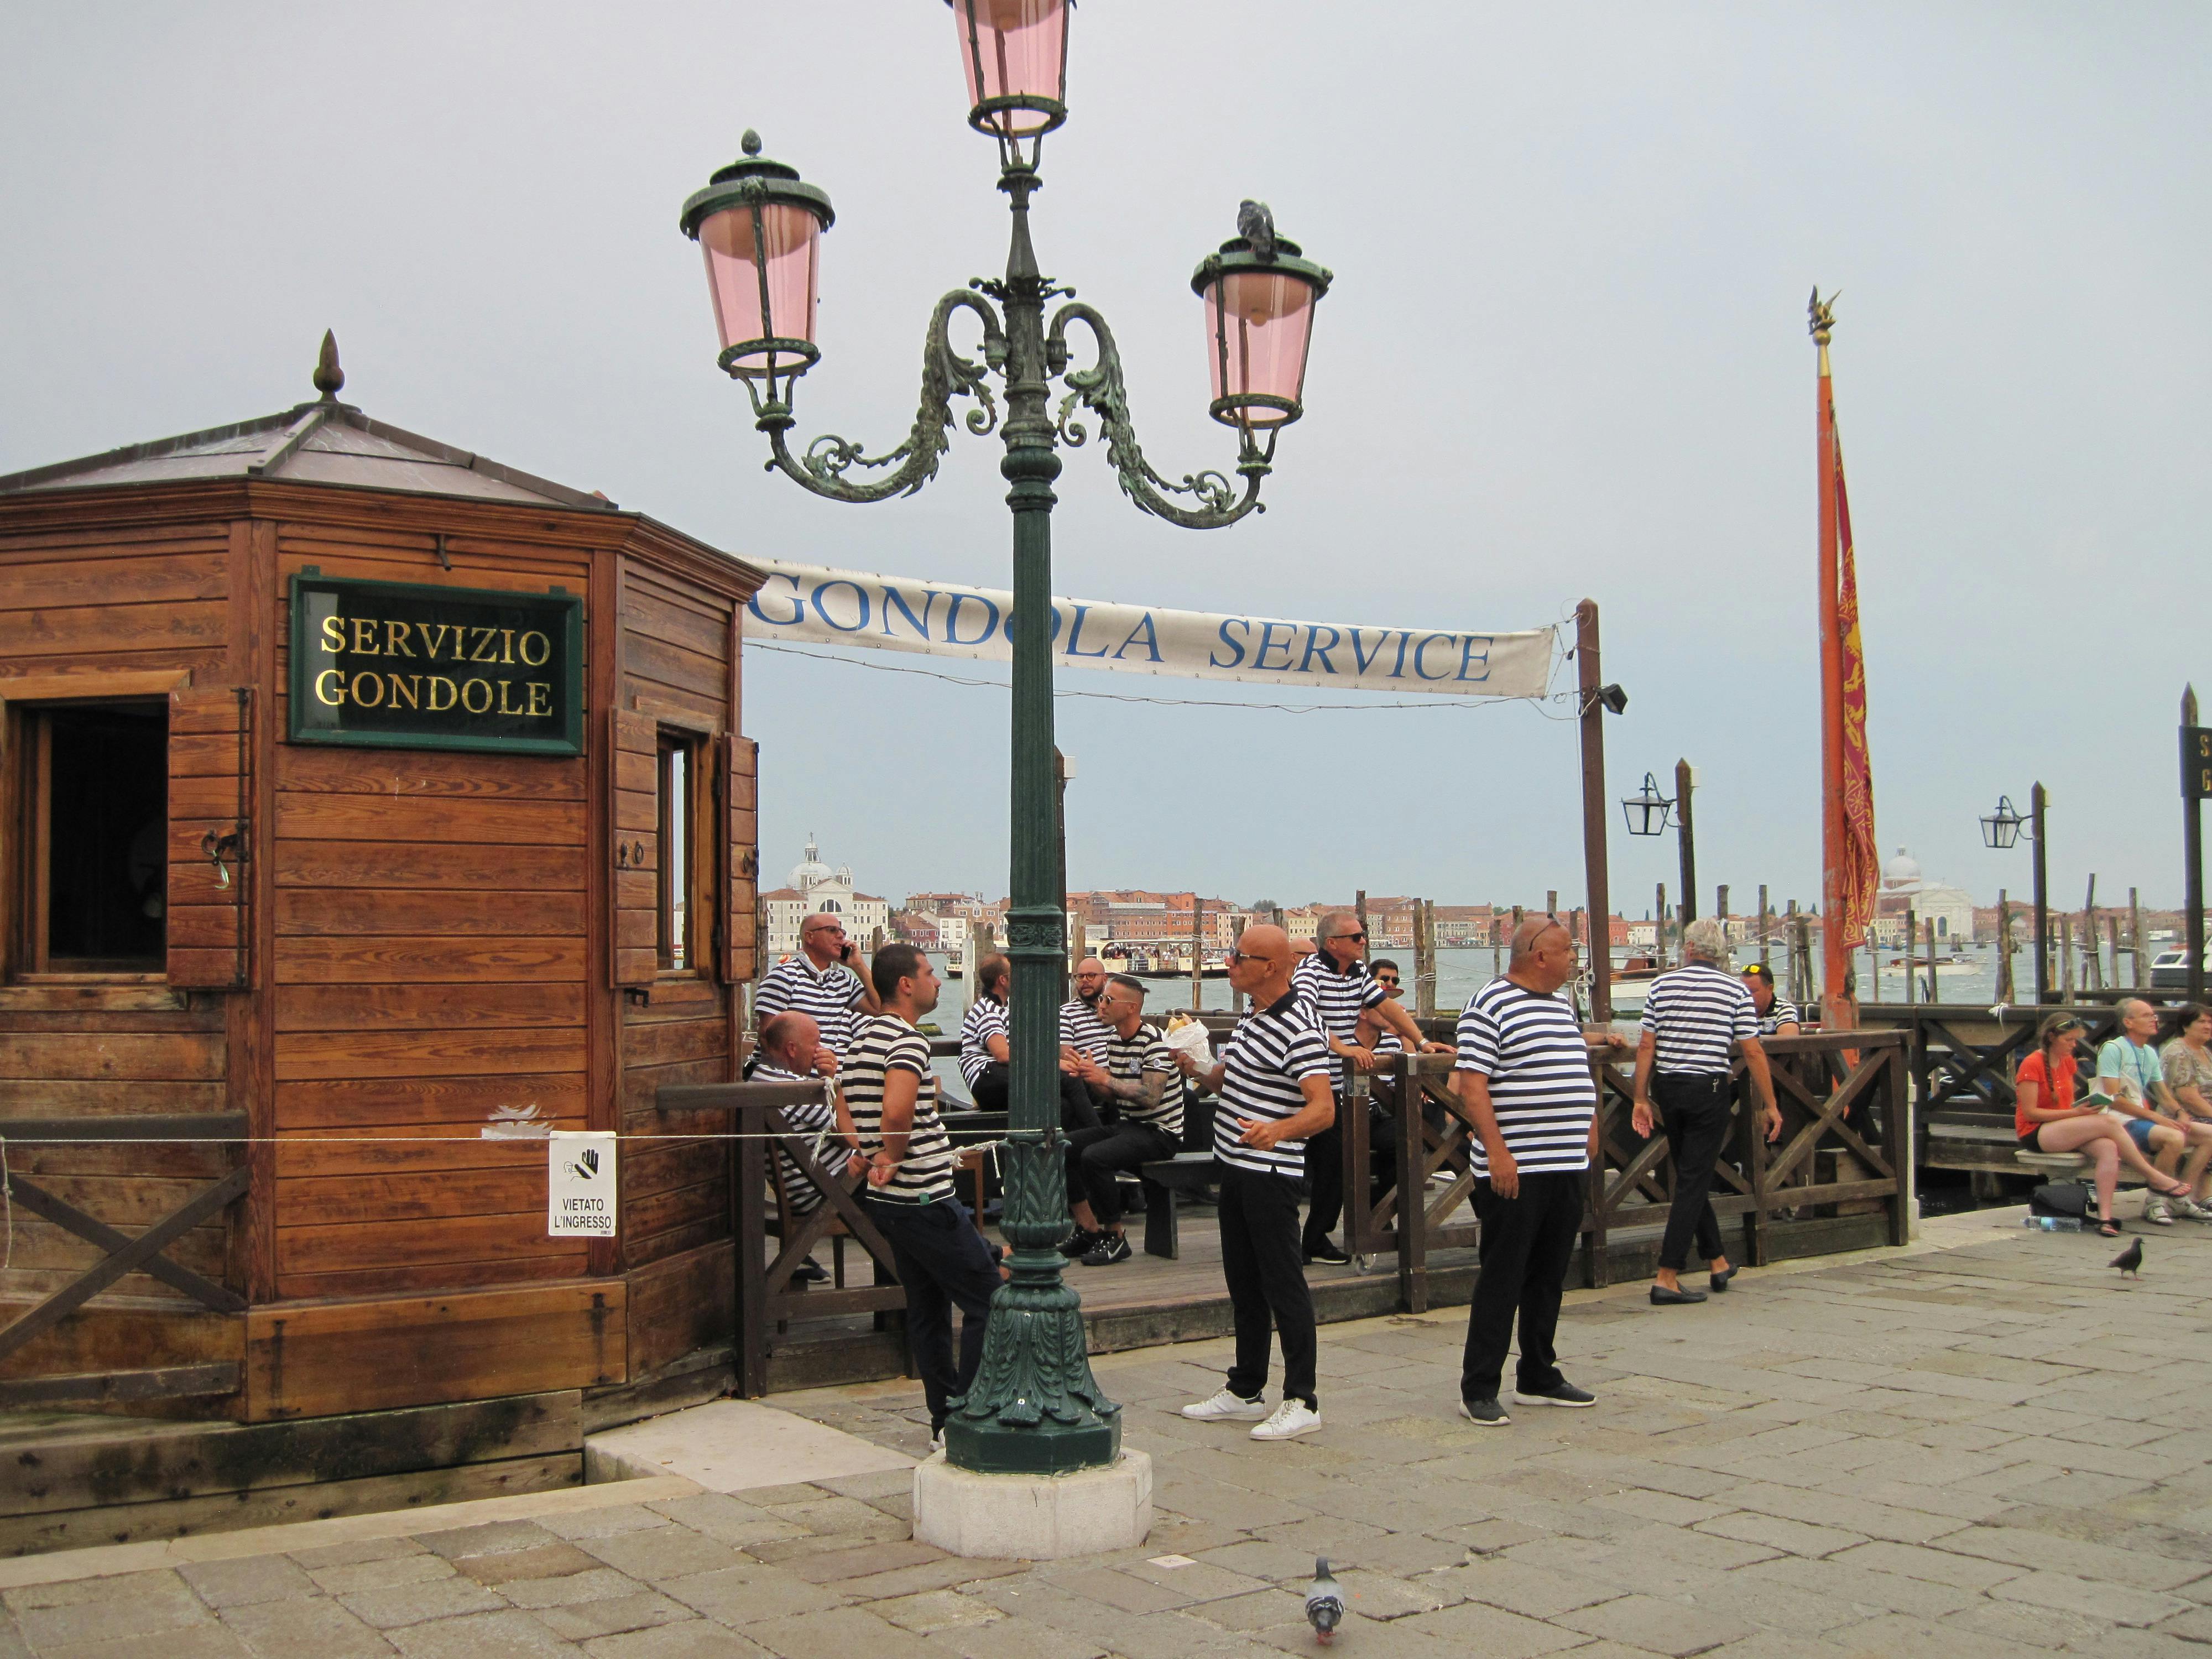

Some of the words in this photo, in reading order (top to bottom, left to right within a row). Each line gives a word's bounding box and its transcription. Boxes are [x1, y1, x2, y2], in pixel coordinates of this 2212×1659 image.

[321, 615, 551, 666] SERVIZIO
[1209, 618, 1495, 682] SERVICE
[315, 669, 552, 717] GONDOLE
[554, 1215, 612, 1229] L'INGRESSO
[562, 1198, 604, 1211] VIETATO
